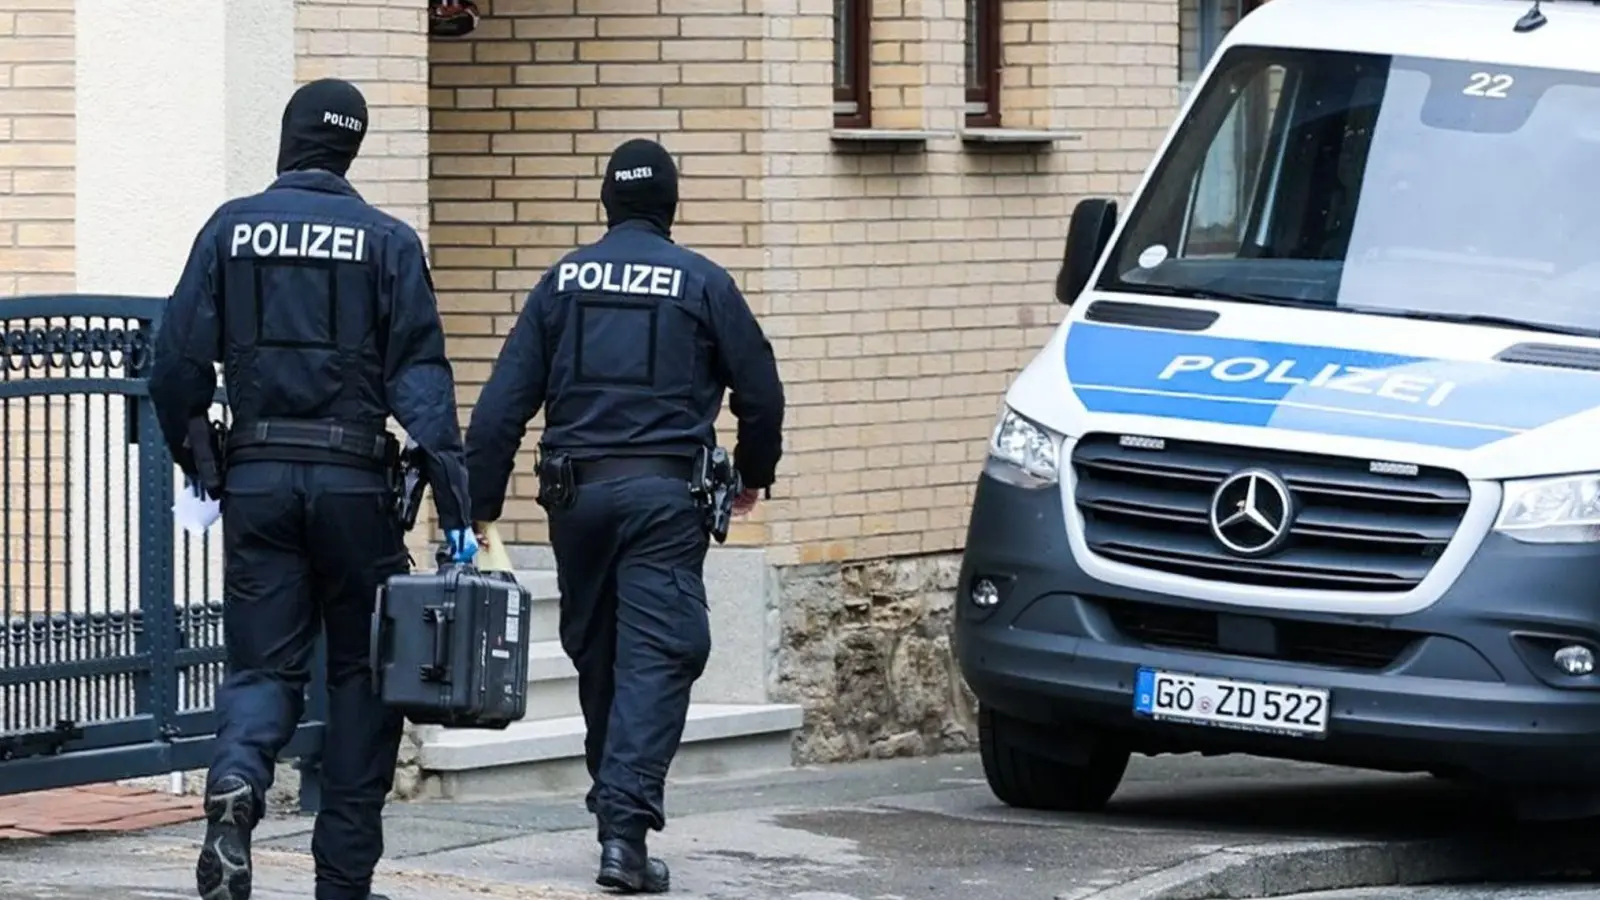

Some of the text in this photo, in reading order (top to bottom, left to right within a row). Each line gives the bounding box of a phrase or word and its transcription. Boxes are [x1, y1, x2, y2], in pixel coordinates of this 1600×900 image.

[1462, 71, 1514, 98] 22
[323, 111, 362, 132] POLIZEI
[614, 165, 653, 182] POLIZEI
[230, 222, 365, 262] POLIZEI
[557, 261, 682, 297] POLIZEI
[1157, 354, 1456, 407] POLIZEI
[1156, 678, 1195, 711] GÖ
[1215, 685, 1256, 718] ZD
[1263, 690, 1322, 726] 522
